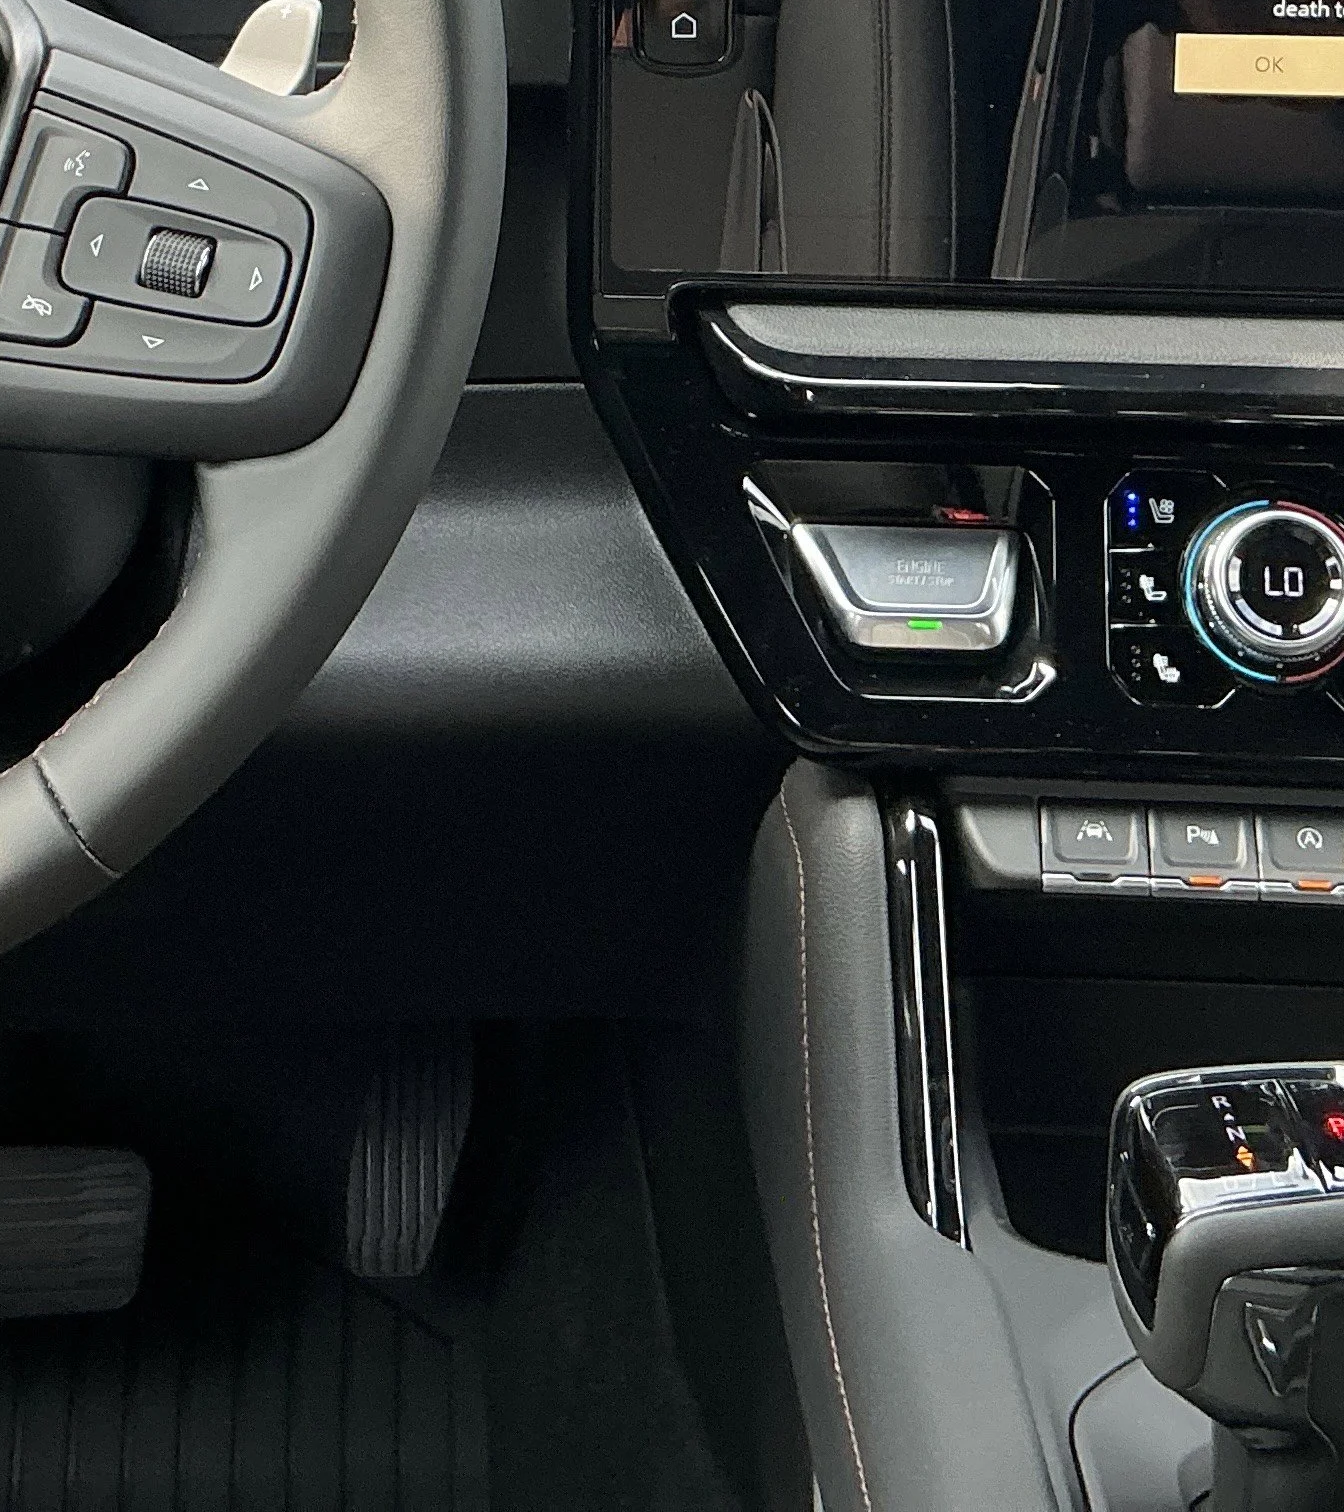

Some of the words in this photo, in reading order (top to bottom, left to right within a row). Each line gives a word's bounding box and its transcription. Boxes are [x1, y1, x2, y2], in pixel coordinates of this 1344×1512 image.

[1254, 55, 1285, 74] OK
[1211, 1095, 1231, 1110] R
[1226, 1125, 1246, 1142] N
